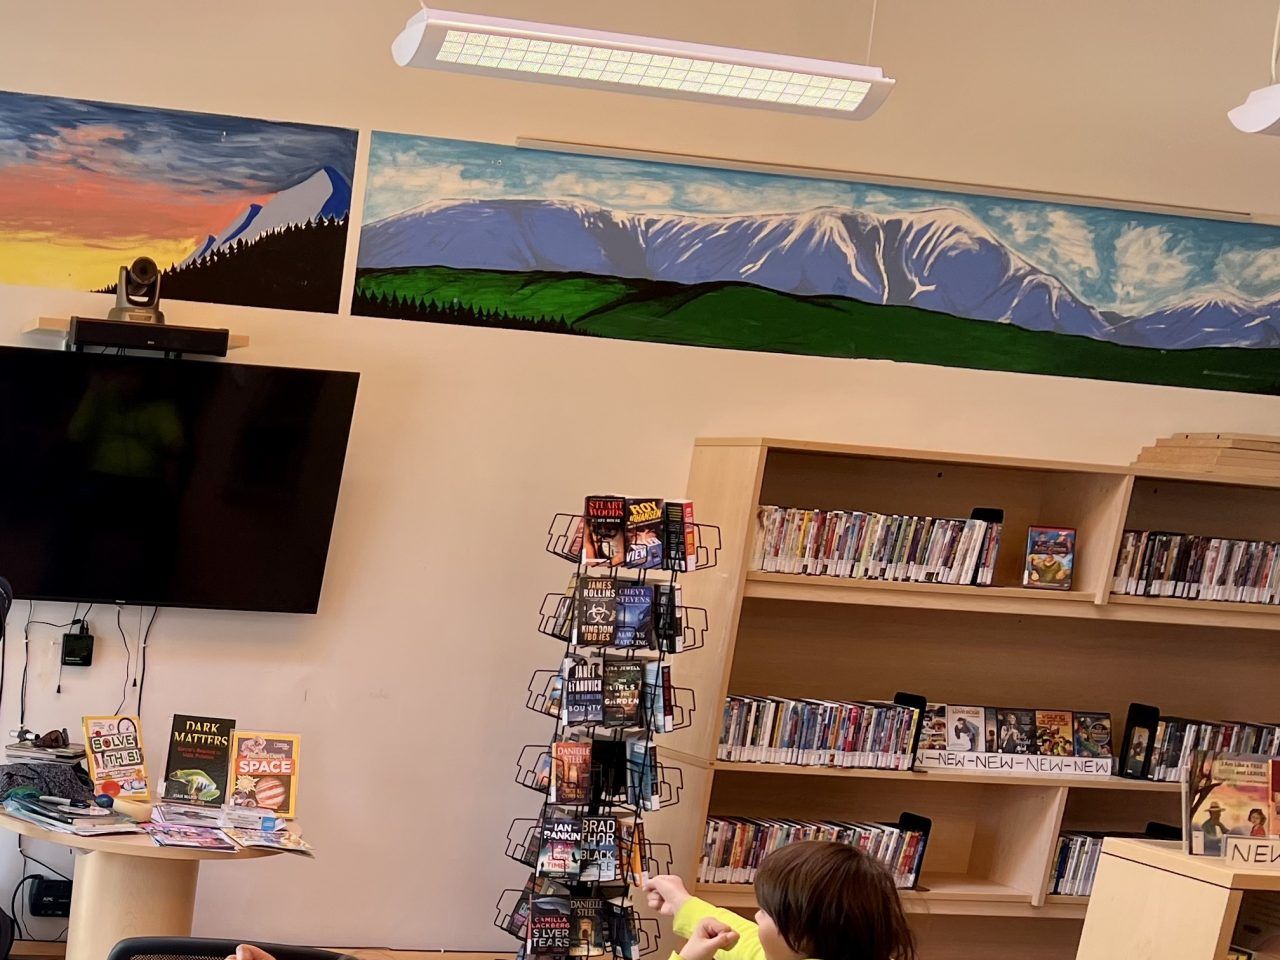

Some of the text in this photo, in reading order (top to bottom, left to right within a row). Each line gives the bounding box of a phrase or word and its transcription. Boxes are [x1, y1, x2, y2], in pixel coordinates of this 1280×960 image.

[589, 501, 625, 509] STUART
[629, 501, 658, 515] ROY
[589, 508, 624, 517] WOODS
[626, 548, 648, 562] VIEW
[587, 581, 612, 590] JAMES
[583, 589, 616, 598] ROLLINS
[618, 588, 646, 596] CHEVY
[616, 595, 651, 603] STEVENS
[186, 720, 220, 733] DARK
[92, 734, 134, 751] SOLVE
[173, 731, 229, 747] MATTERS
[557, 746, 591, 756] DANIELLE
[239, 759, 292, 773] SPACE
[938, 753, 966, 768] NEW
[975, 755, 1014, 770] NEW
[1026, 757, 1064, 772] NEW
[1074, 760, 1110, 774] NEW
[554, 823, 572, 832] IAN
[582, 820, 616, 833] BRAD
[580, 849, 613, 860] BLACK
[570, 900, 603, 909] DANIELLE
[577, 908, 596, 917] STEEL
[532, 928, 570, 938] SLVER
[531, 938, 570, 947] TEARS
